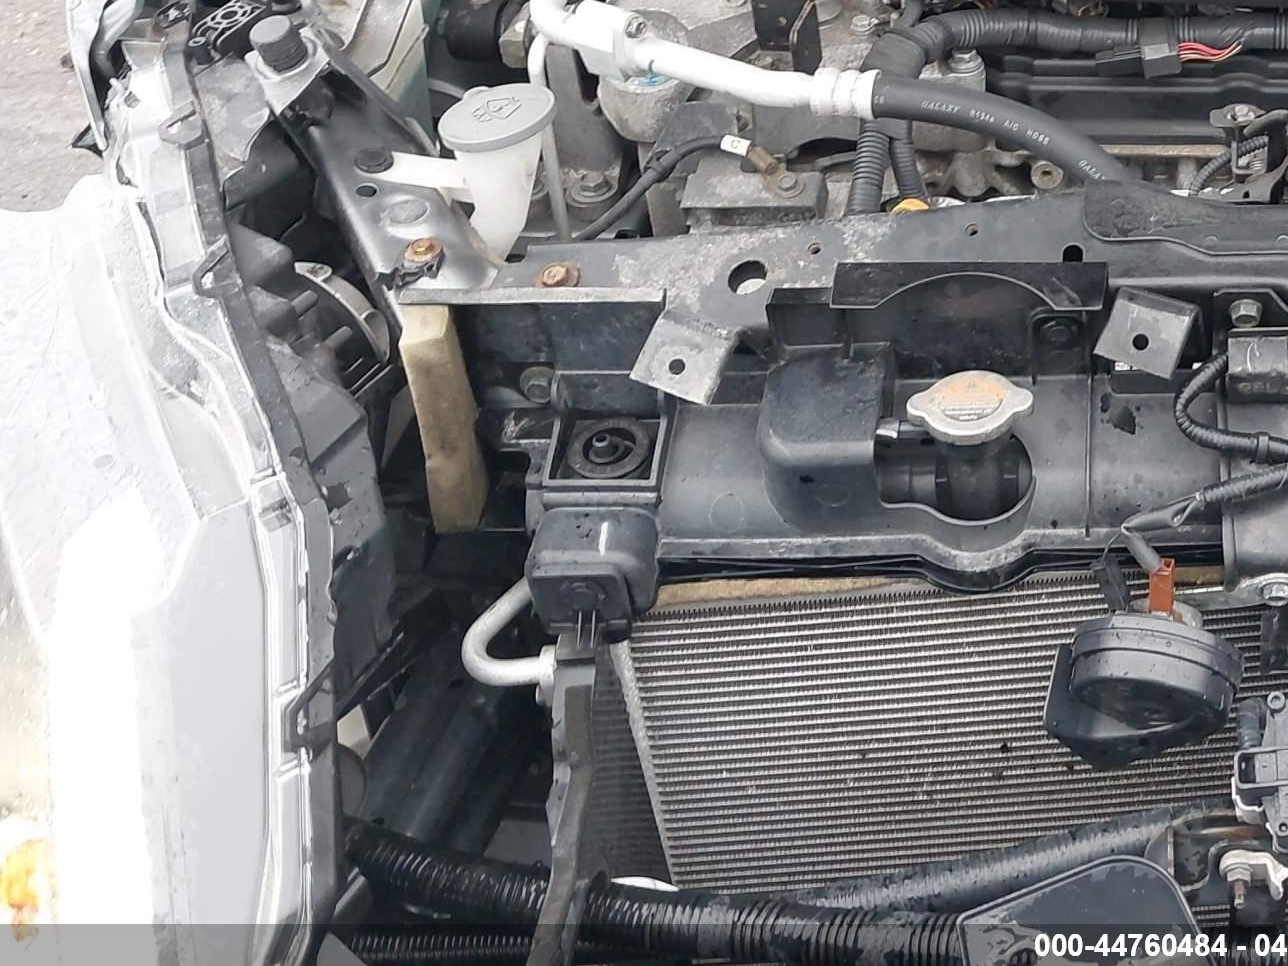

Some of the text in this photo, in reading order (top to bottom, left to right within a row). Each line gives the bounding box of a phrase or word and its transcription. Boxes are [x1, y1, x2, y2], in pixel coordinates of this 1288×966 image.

[920, 99, 961, 114] GALAXY
[1002, 119, 1020, 131] A/C
[1025, 129, 1051, 146] HOSE
